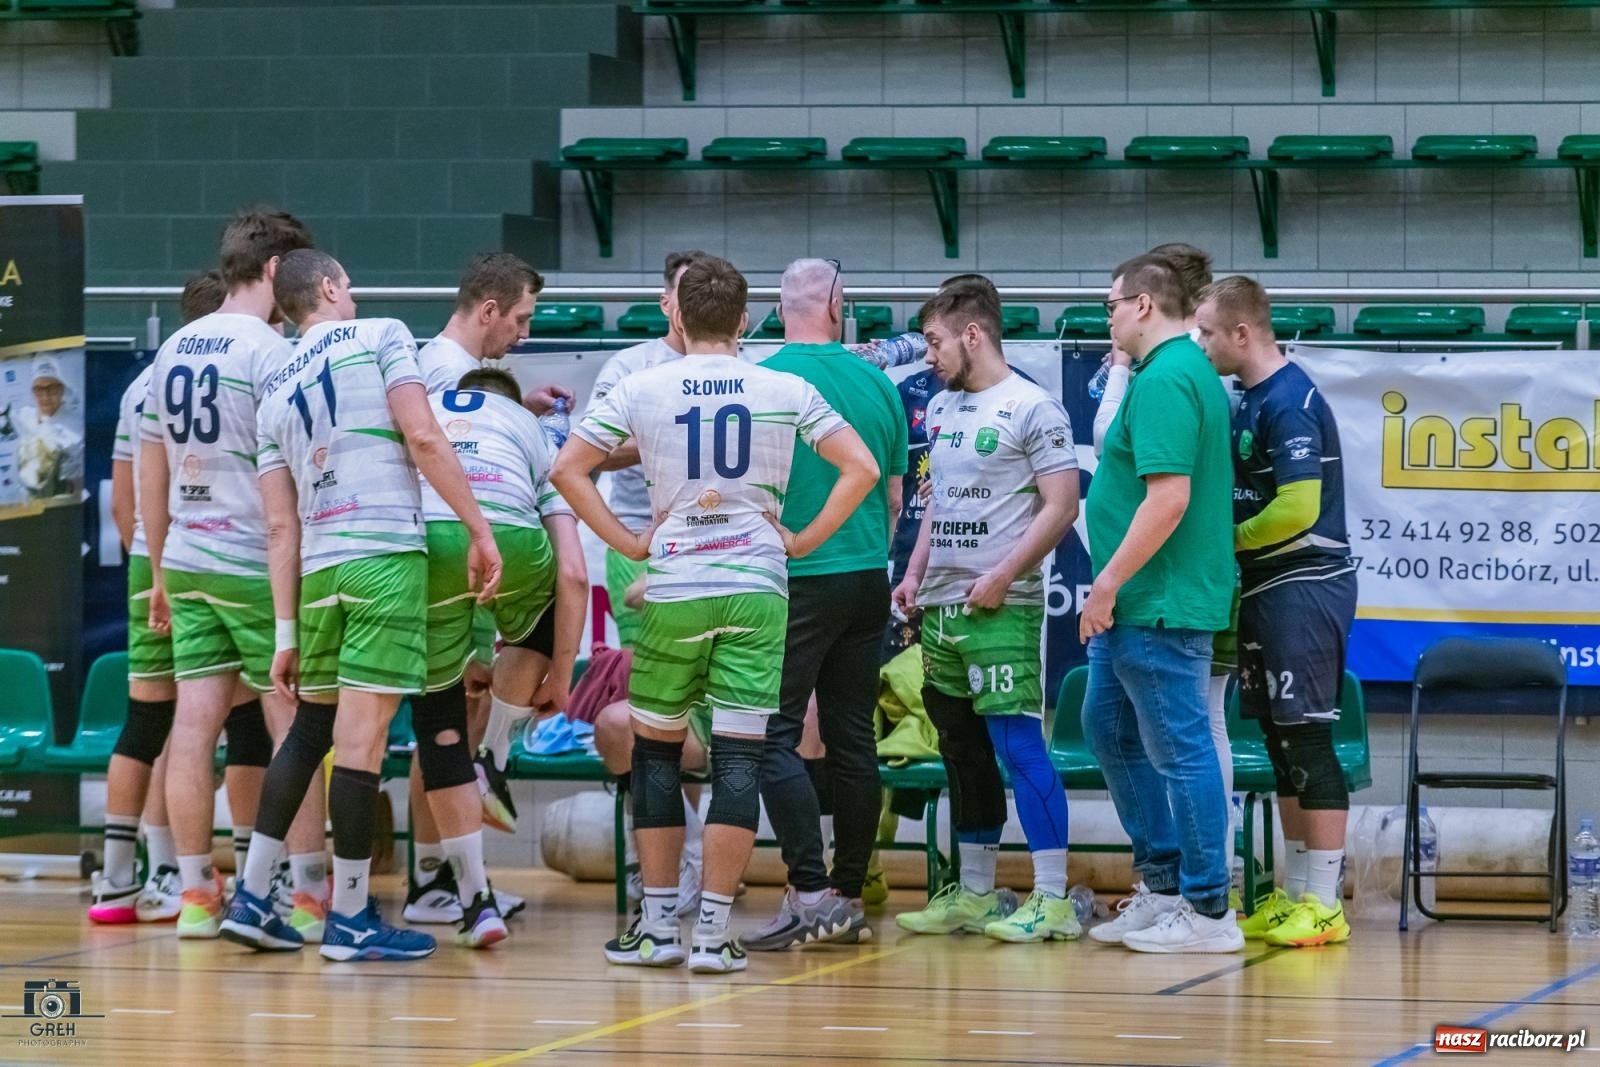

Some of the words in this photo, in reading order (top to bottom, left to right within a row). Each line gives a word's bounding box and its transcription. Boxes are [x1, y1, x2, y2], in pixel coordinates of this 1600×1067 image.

[0, 259, 23, 286] A
[176, 334, 236, 356] GÓRNIAK
[287, 356, 337, 442] 11
[682, 378, 745, 396] SŁOWIK
[164, 363, 221, 445] 93
[674, 403, 752, 481] 10
[950, 431, 965, 449] 13
[947, 486, 991, 499] GUARD
[943, 521, 989, 535] CIEPŁA
[1360, 519, 1391, 540] 32
[1401, 520, 1451, 542] 414
[1460, 521, 1490, 543] 92
[1500, 520, 1538, 546] 88,
[1553, 523, 1600, 544] 502
[695, 539, 752, 552] ZAWIERCIE
[936, 538, 953, 548] 944
[955, 539, 978, 548] 146
[1439, 556, 1558, 585] Racibórz,
[1567, 558, 1599, 582] ul.
[987, 664, 1014, 693] 13
